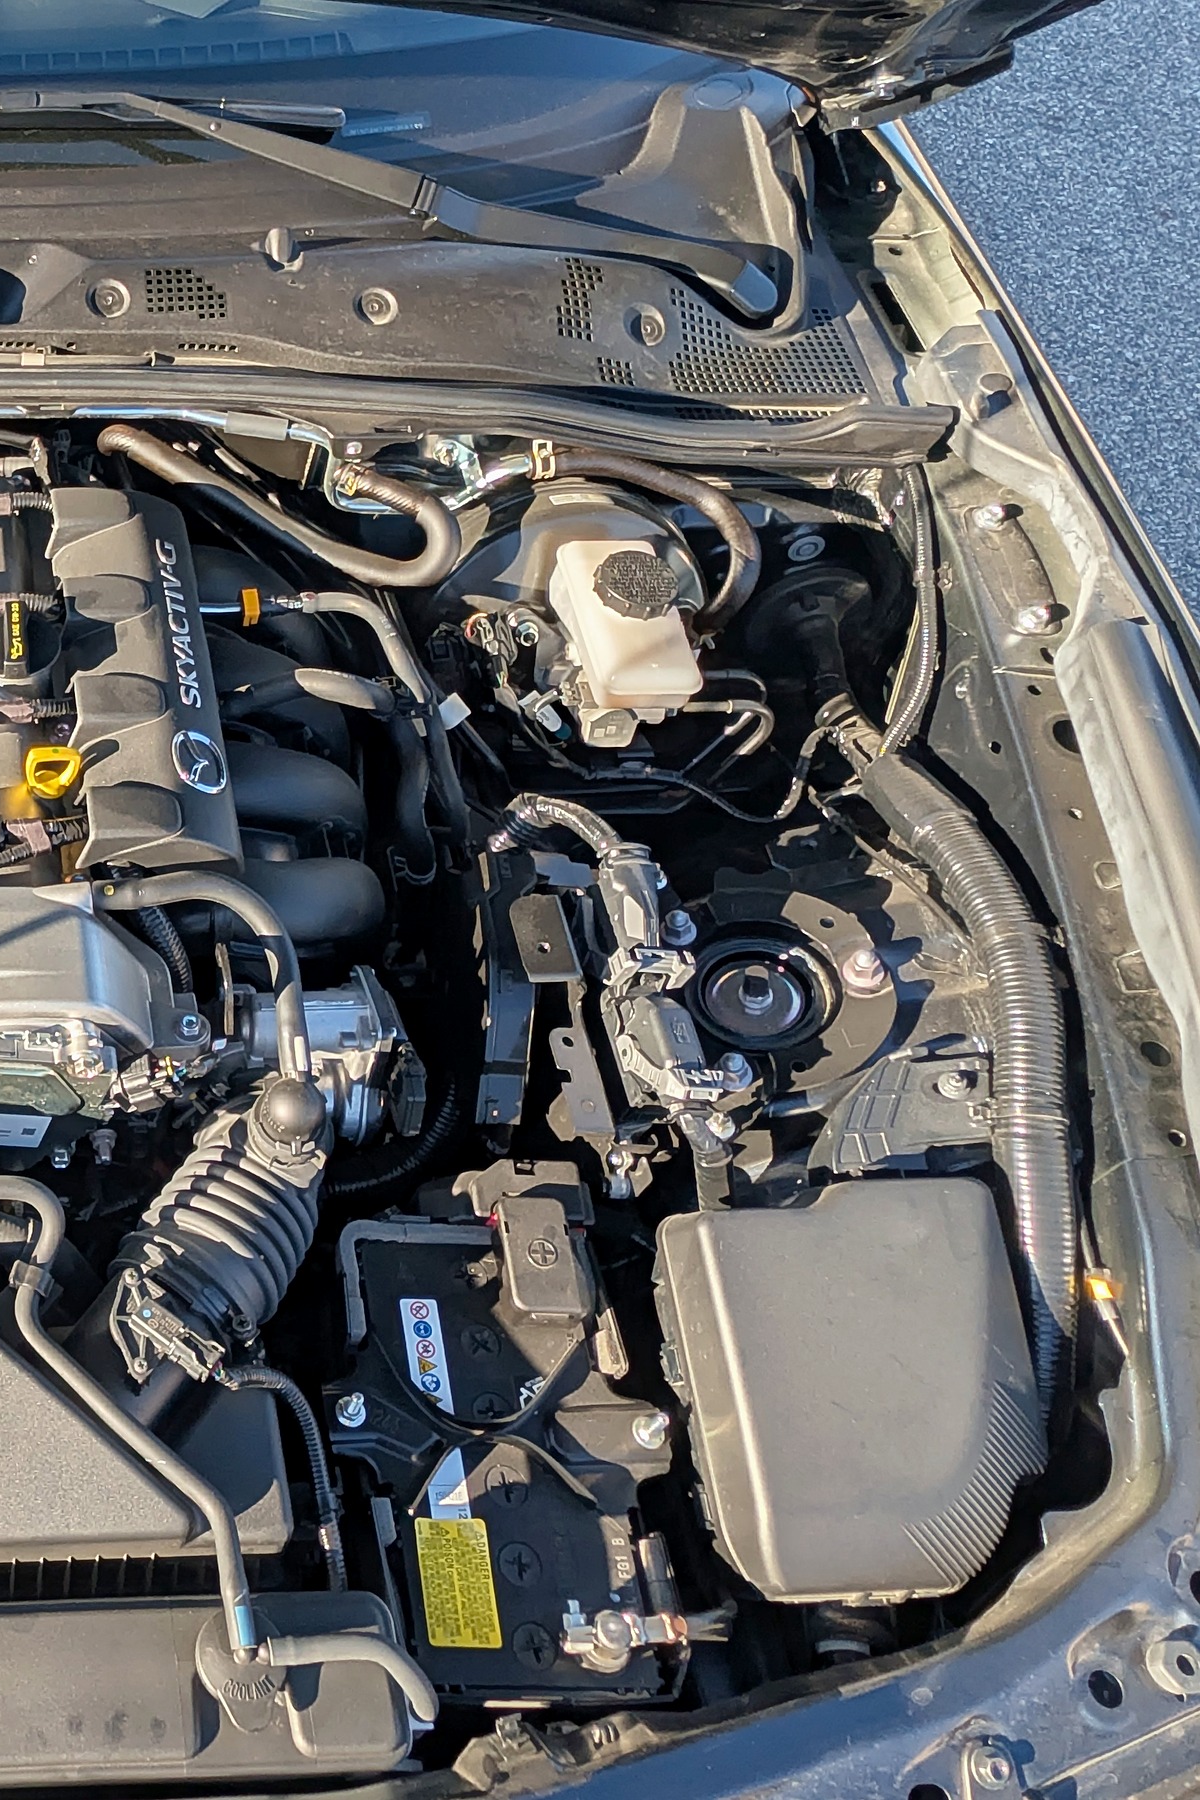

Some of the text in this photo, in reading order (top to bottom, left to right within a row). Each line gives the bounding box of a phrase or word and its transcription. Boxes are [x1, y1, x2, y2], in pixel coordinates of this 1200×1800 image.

[155, 538, 202, 708] SKYACTIV-G
[441, 1538, 454, 1571] POISON
[477, 1541, 490, 1580] DANGER
[222, 1674, 275, 1701] COOLANT
